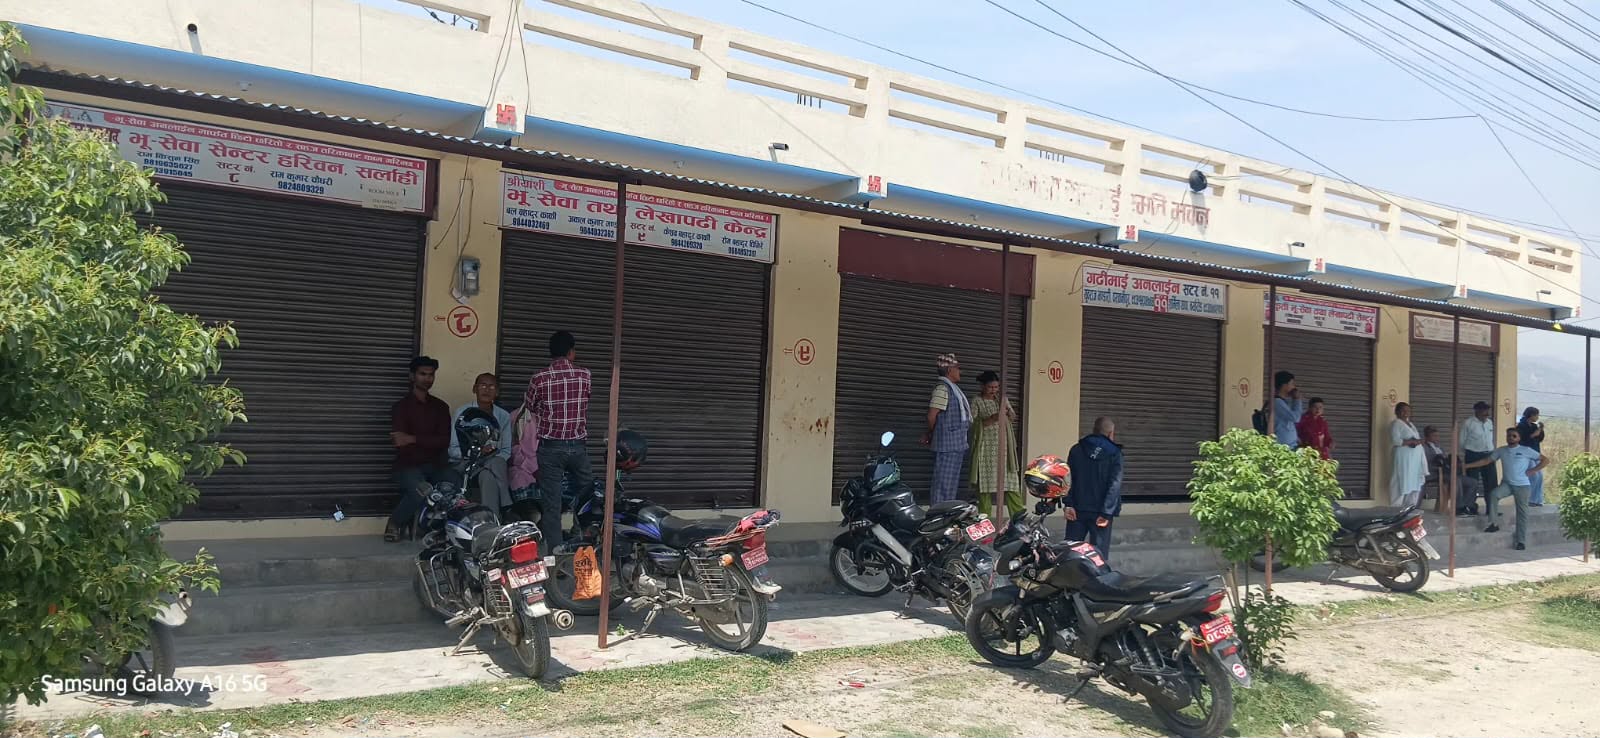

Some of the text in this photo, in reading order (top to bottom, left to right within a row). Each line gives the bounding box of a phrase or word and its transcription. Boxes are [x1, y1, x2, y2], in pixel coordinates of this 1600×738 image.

[129, 131, 202, 154] भू-सेवा
[208, 140, 272, 164] सेन्टर
[355, 165, 419, 186] सर्लाही
[216, 161, 241, 172] सटर
[228, 172, 240, 183] ८
[507, 188, 580, 210] भू-सेवा
[635, 204, 718, 230] लेखापढी
[723, 218, 769, 239] केन्द्र
[1086, 270, 1129, 290] गढीमाई
[1132, 277, 1180, 295] अनलाईन
[454, 313, 471, 333] ८
[1050, 367, 1061, 380] १०
